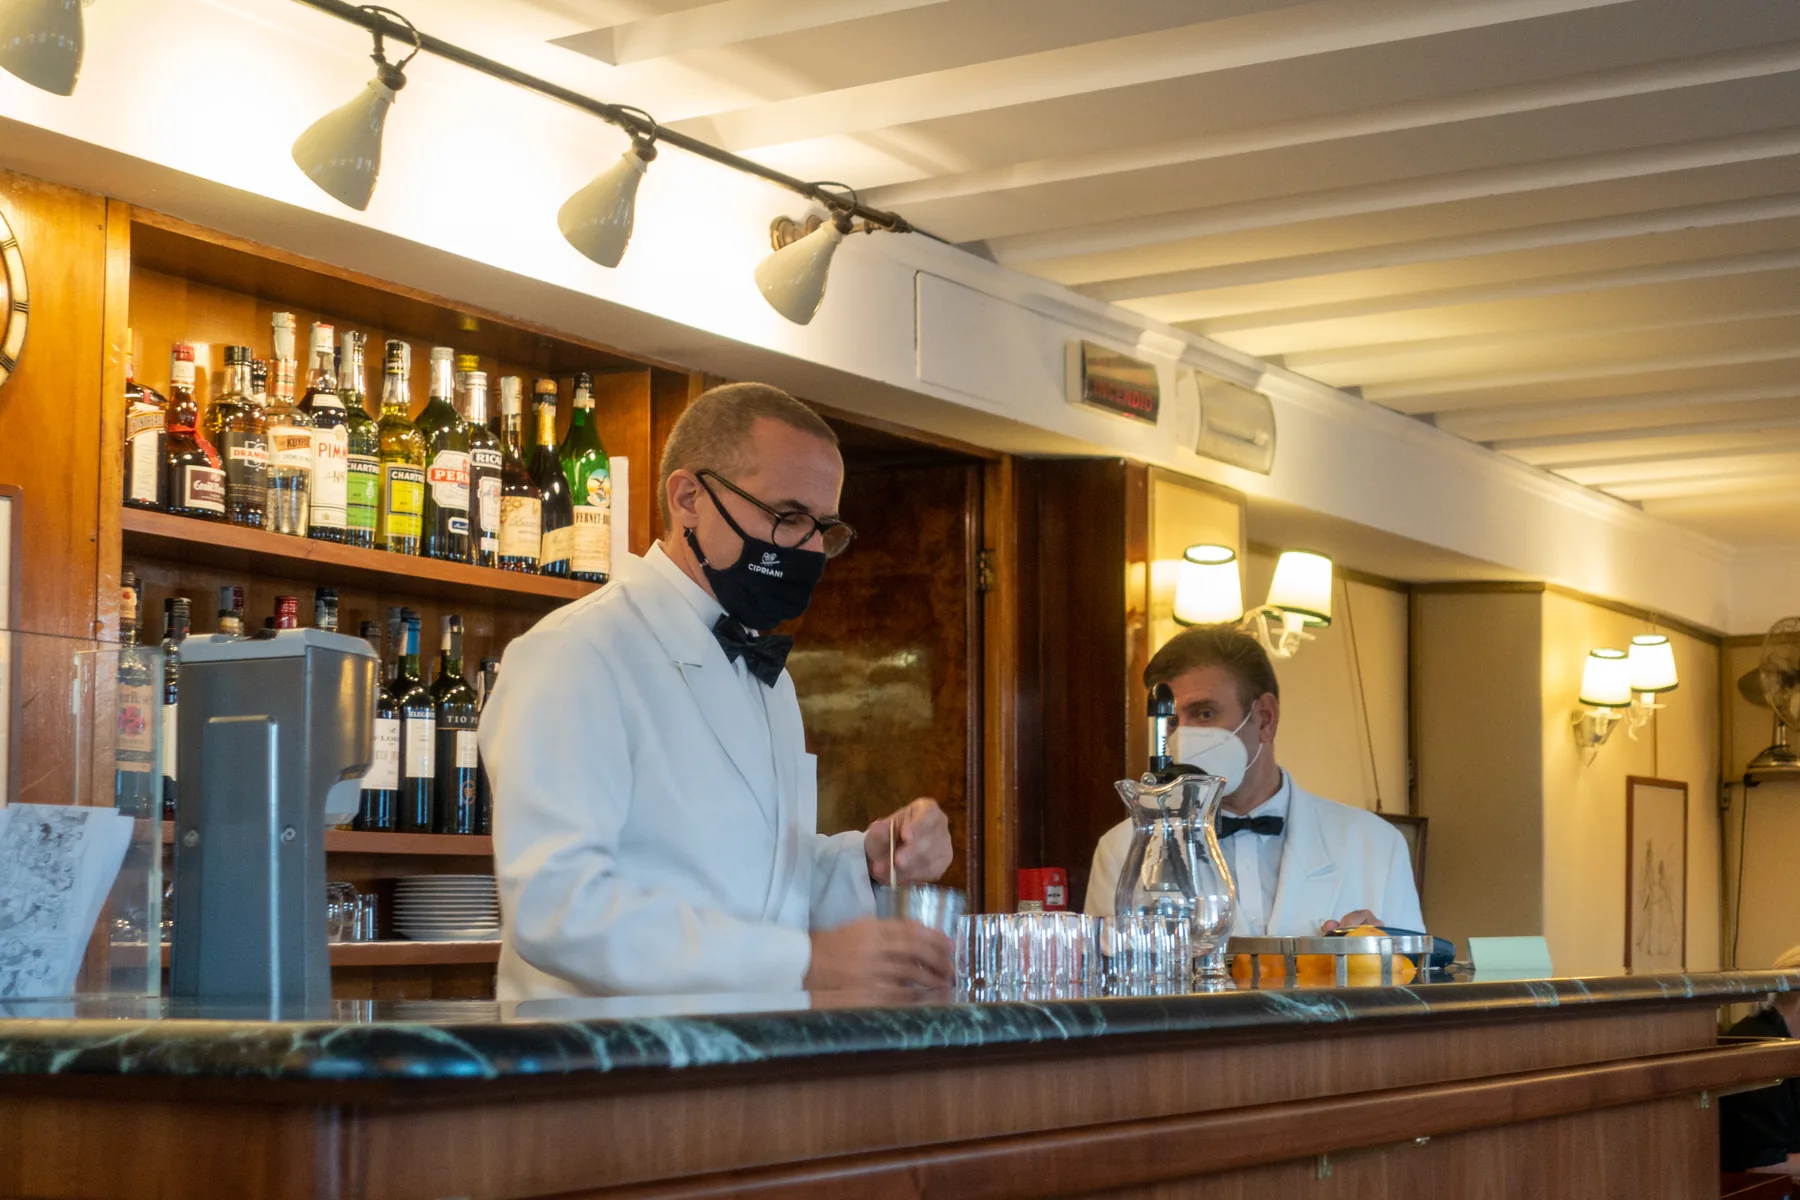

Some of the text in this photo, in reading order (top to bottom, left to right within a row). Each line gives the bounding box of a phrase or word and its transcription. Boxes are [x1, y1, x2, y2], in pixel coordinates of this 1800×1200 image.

[1093, 381, 1153, 412] INCENDIO
[748, 563, 783, 578] CIPRIANI
[447, 715, 467, 723] TIO
